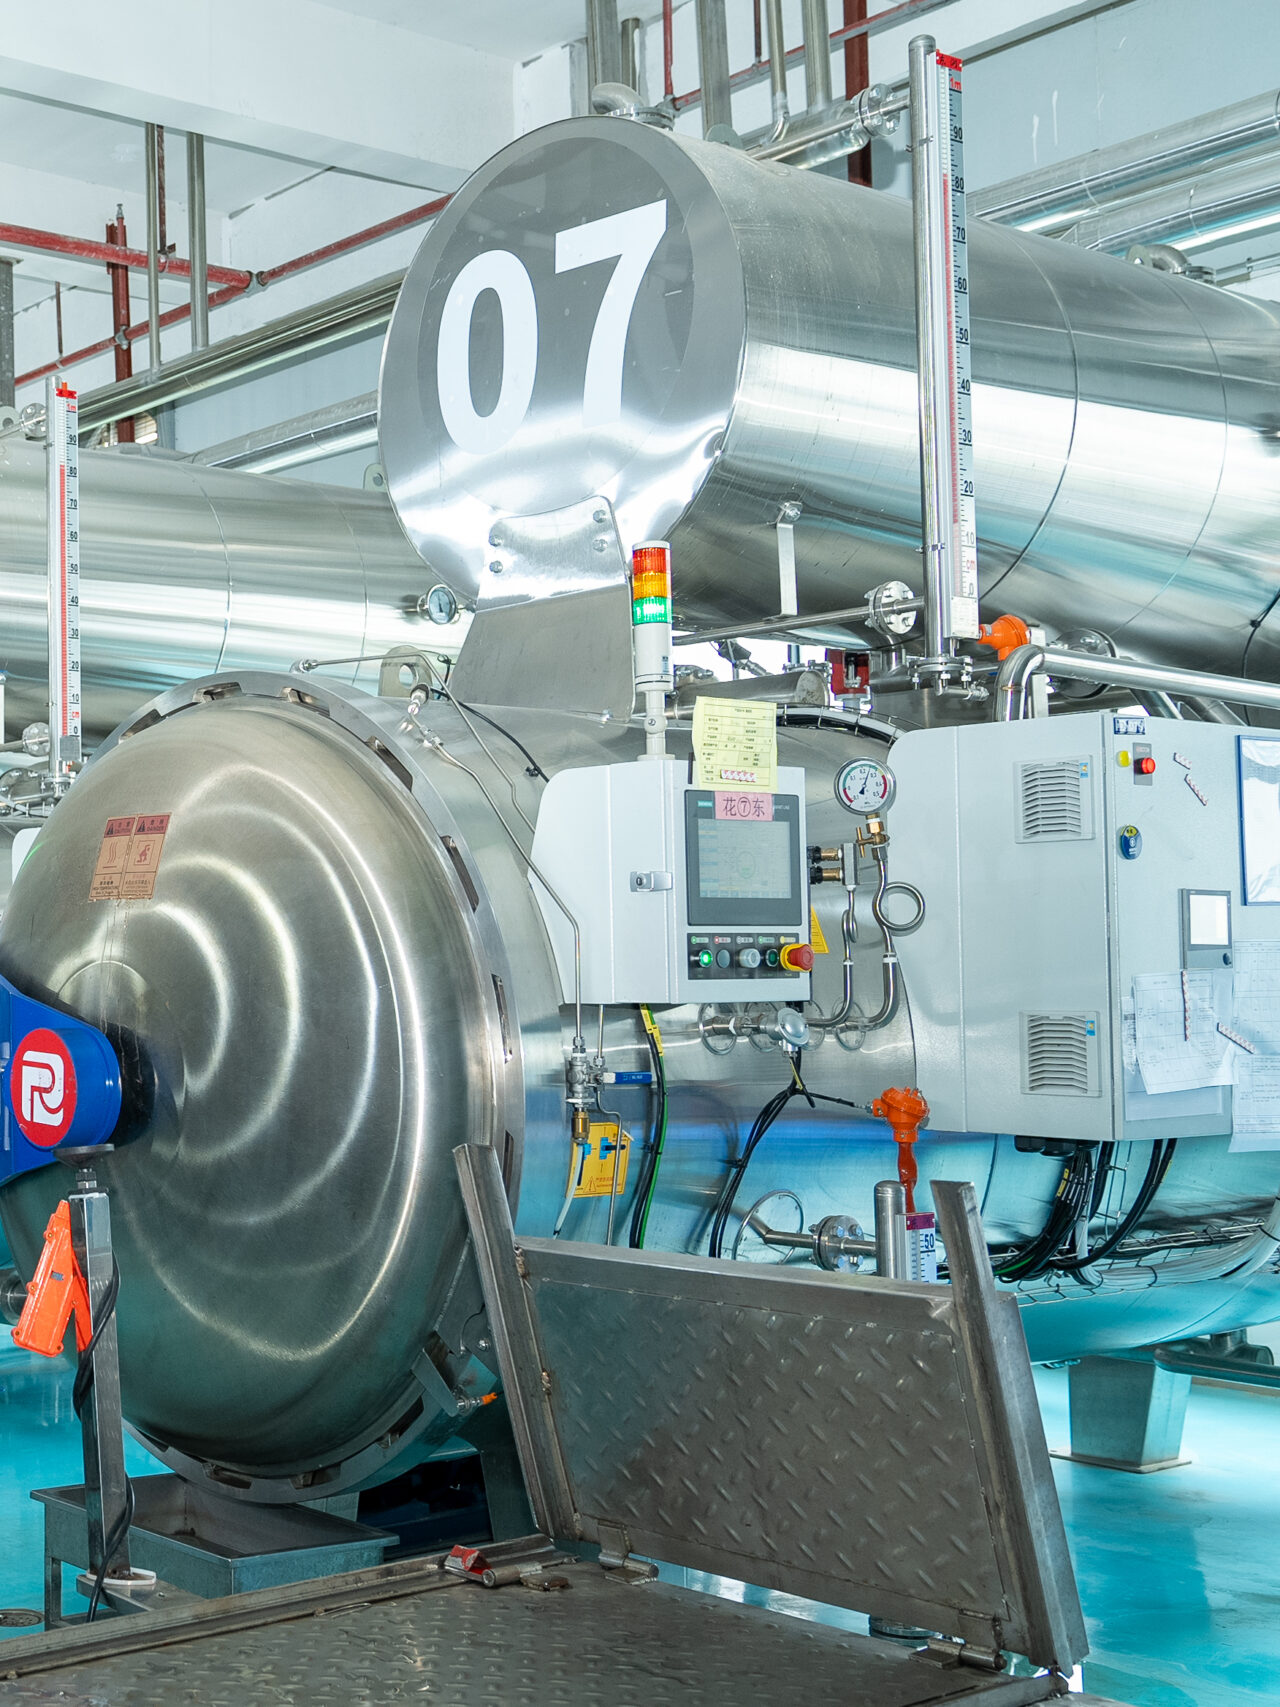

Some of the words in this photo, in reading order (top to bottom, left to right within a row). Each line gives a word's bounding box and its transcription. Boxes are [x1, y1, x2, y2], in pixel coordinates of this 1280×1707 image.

[950, 77, 962, 90] 1m
[953, 127, 963, 140] 90
[955, 176, 965, 190] 80
[956, 227, 966, 241] 70
[958, 278, 967, 291] 60
[437, 199, 667, 455] 07
[959, 329, 969, 342] 50
[961, 379, 971, 392] 40
[69, 435, 77, 443] 90
[962, 430, 972, 443] 30
[70, 467, 77, 475] 80
[964, 481, 974, 494] 20
[70, 499, 77, 507] 70
[70, 531, 78, 540] 60
[966, 532, 975, 545] 10
[71, 564, 78, 572] 50
[969, 583, 974, 596] 0
[71, 596, 78, 604] 40
[71, 629, 79, 637] 30
[71, 661, 79, 669] 20
[72, 694, 79, 702] 10
[74, 726, 78, 734] 0
[723, 797, 765, 817] 花⑦东
[924, 1233, 934, 1249] 50
